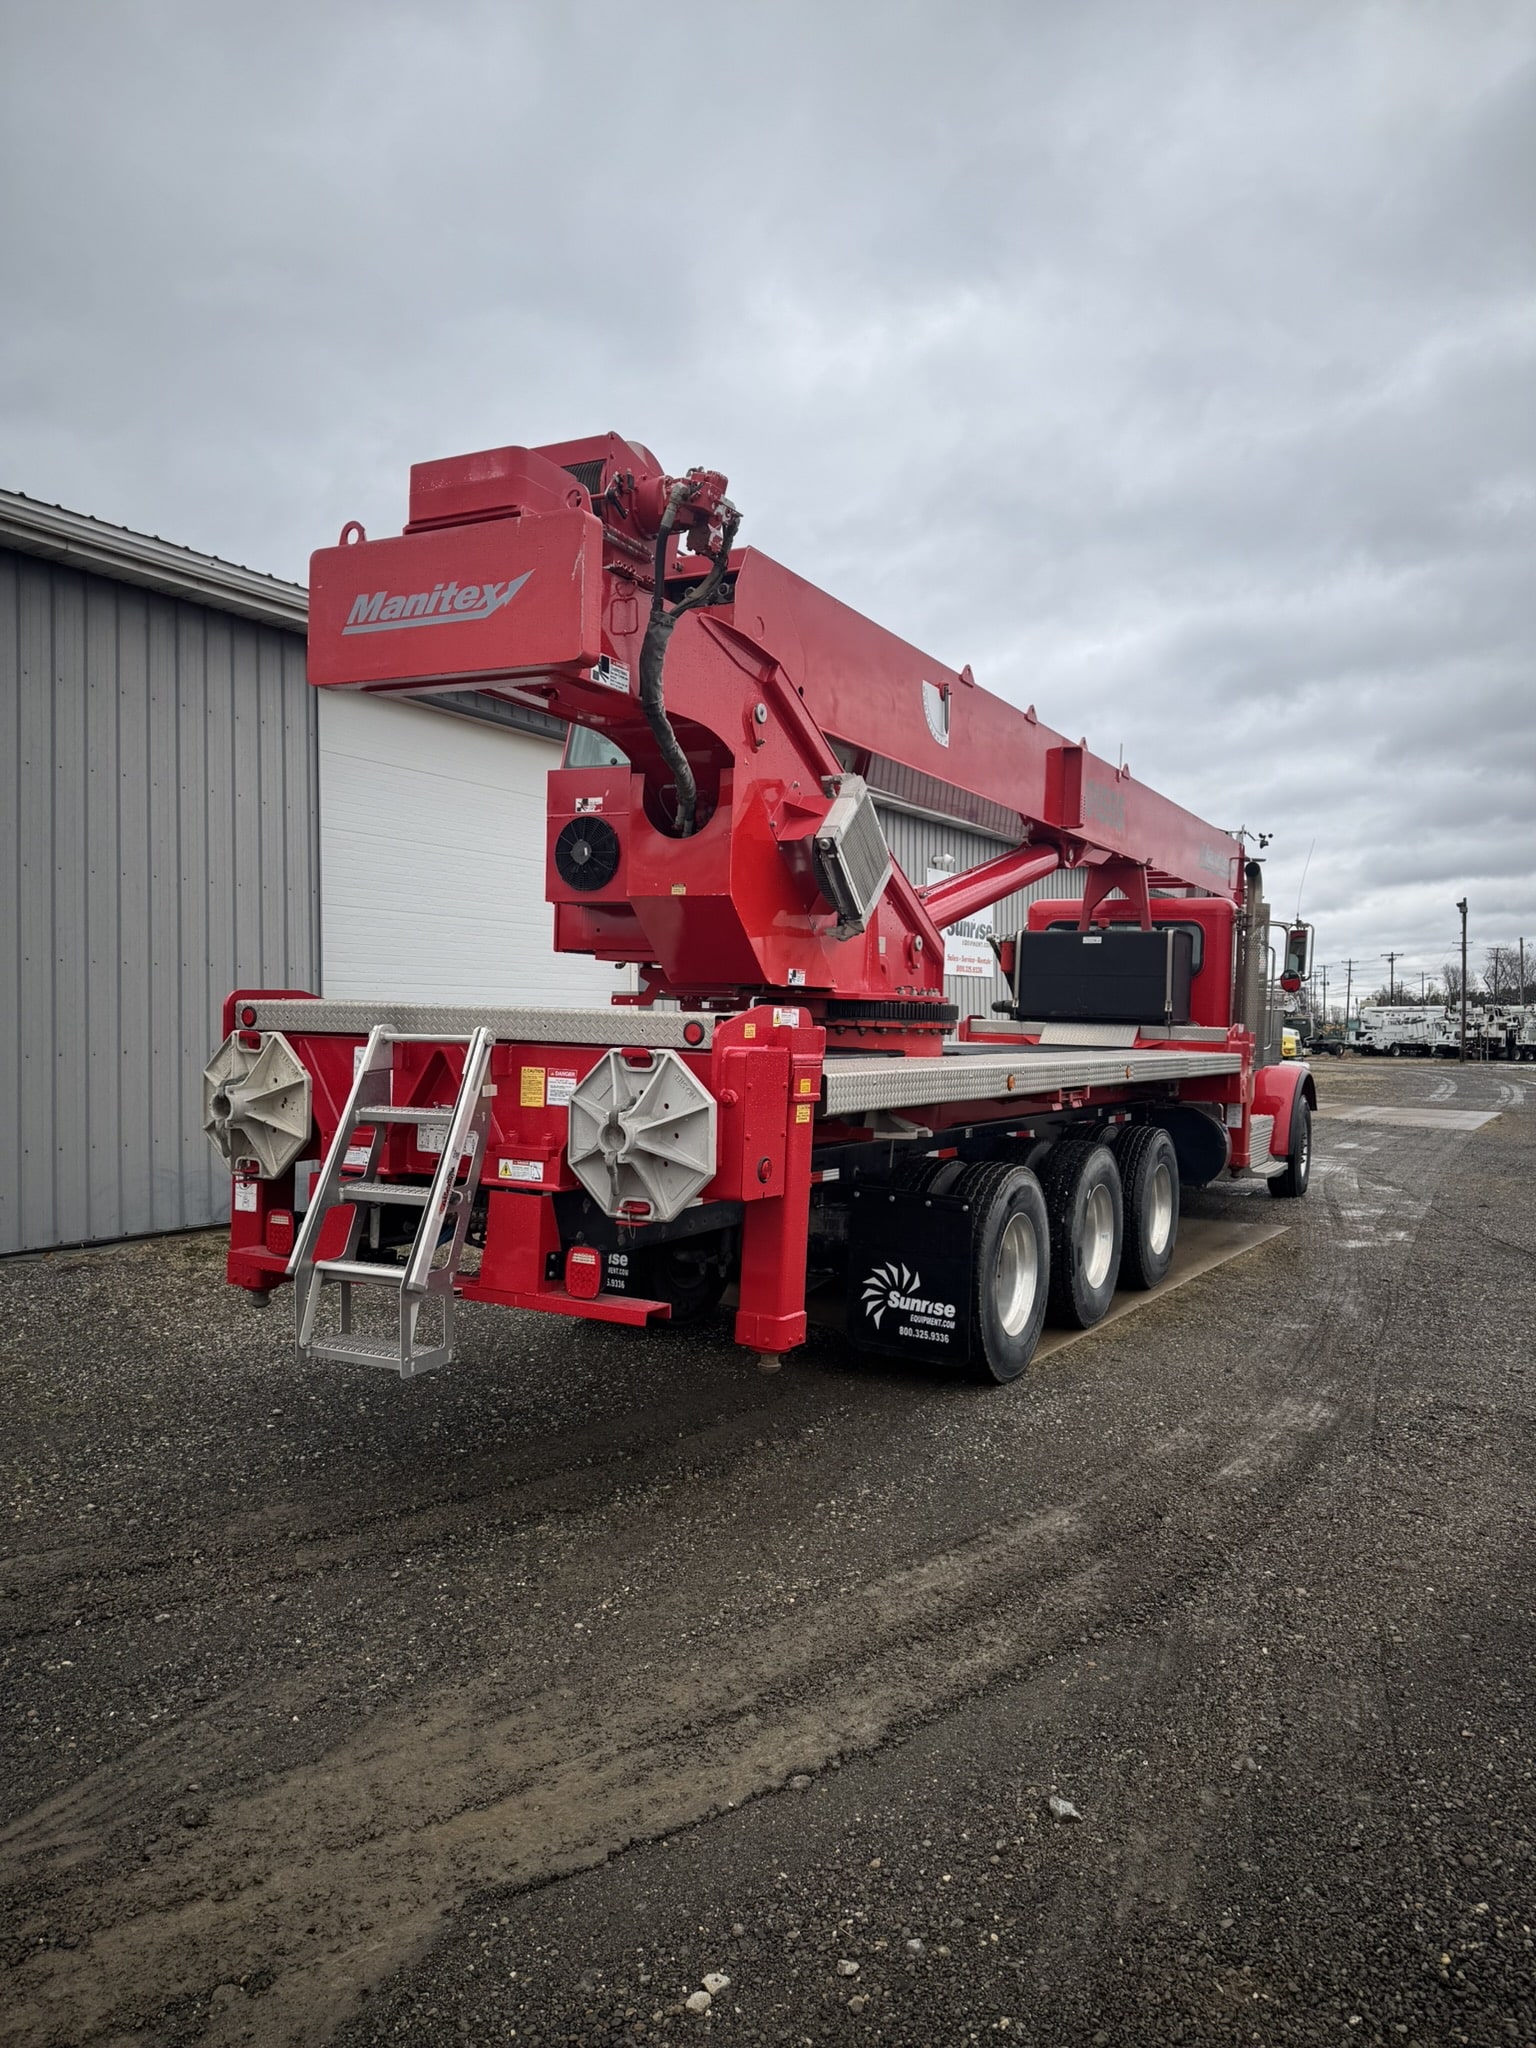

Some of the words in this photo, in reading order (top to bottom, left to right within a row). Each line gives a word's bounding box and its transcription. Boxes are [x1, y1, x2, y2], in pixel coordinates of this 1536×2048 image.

[346, 581, 506, 625] Manitex
[887, 1290, 956, 1318] Sunrise
[910, 1314, 956, 1330] EQUIPMENT.COM
[899, 1326, 950, 1344] 800.325.9336
